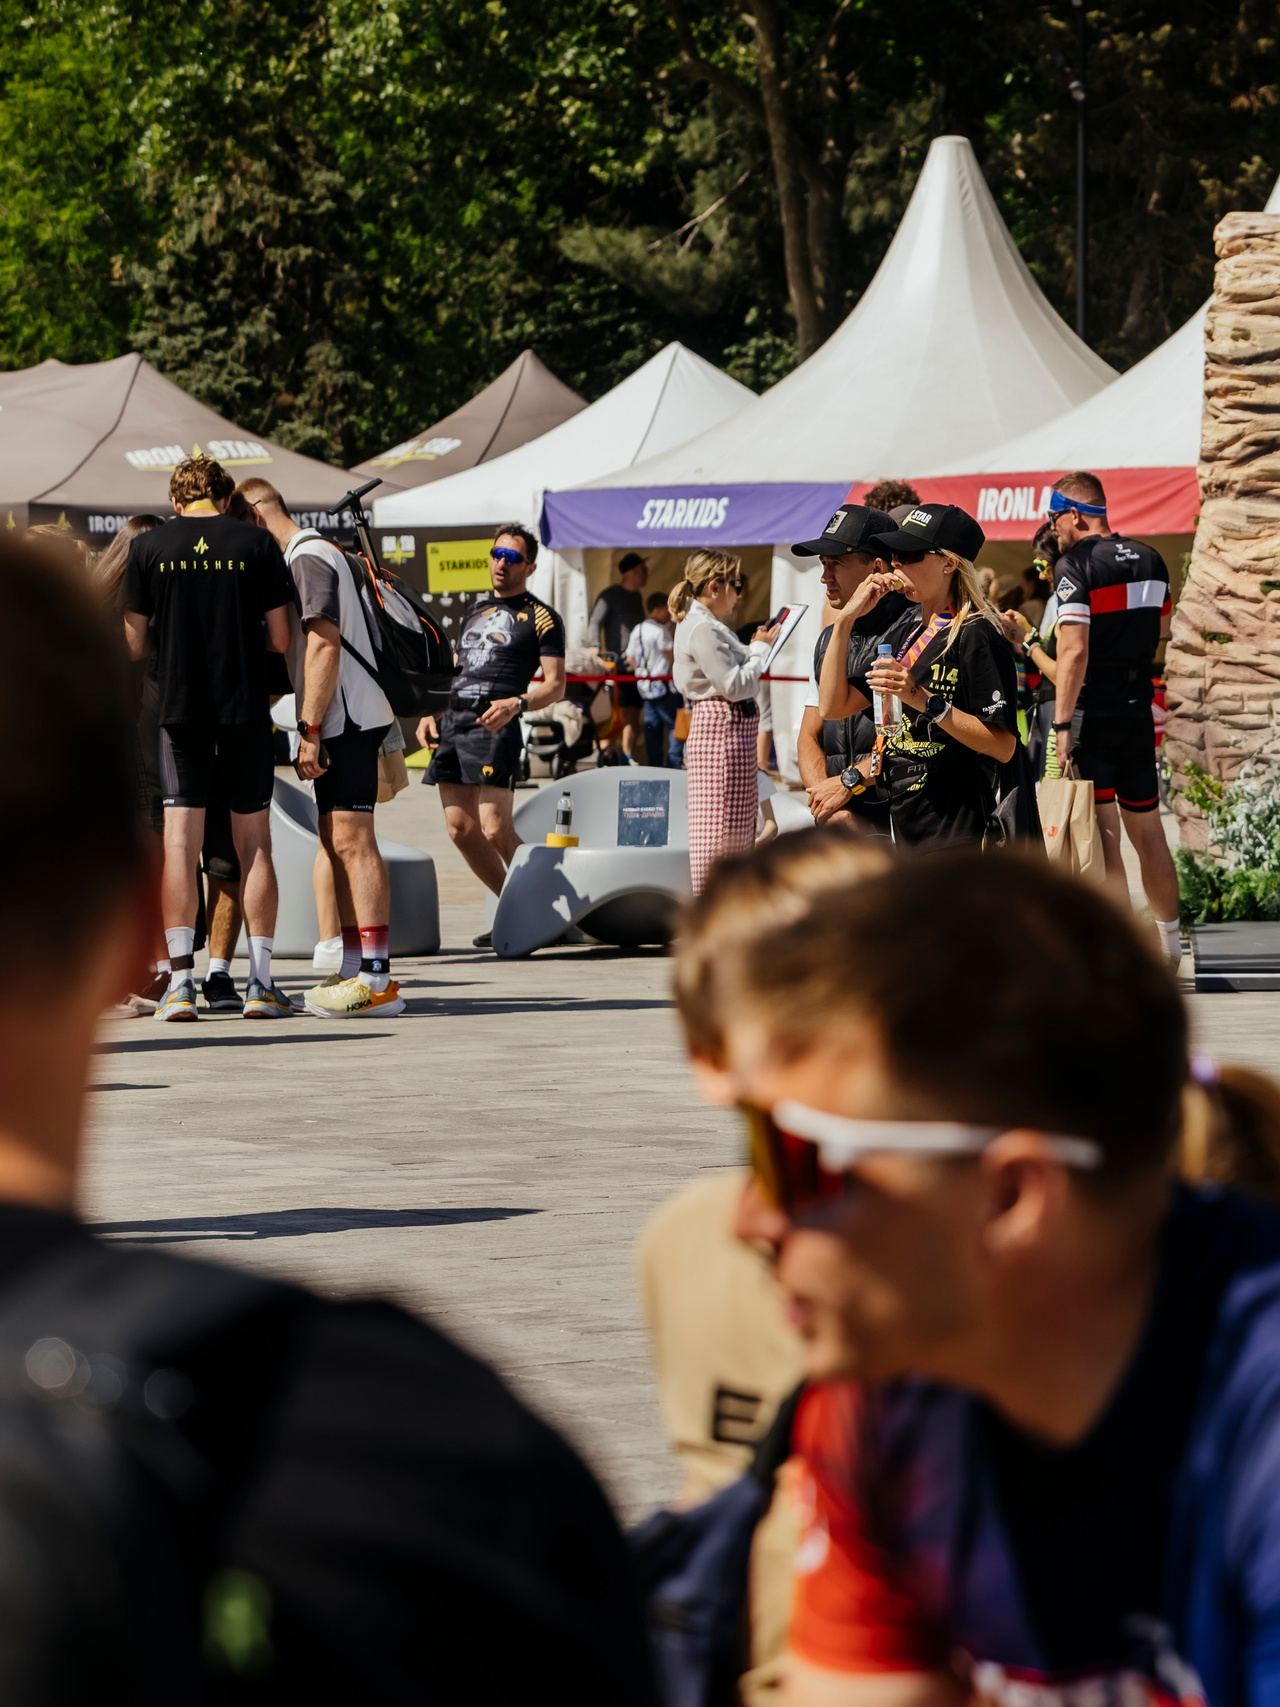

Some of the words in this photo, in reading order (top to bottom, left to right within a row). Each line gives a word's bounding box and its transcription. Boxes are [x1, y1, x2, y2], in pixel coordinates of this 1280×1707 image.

[124, 444, 188, 467] IRON
[207, 439, 270, 460] STAR
[636, 496, 730, 529] STARKIDS
[911, 510, 933, 525] STAR
[88, 515, 134, 533] IRON
[160, 560, 245, 573] FINISHER
[439, 558, 489, 572] STARKIDS
[346, 999, 373, 1013] HOKA
